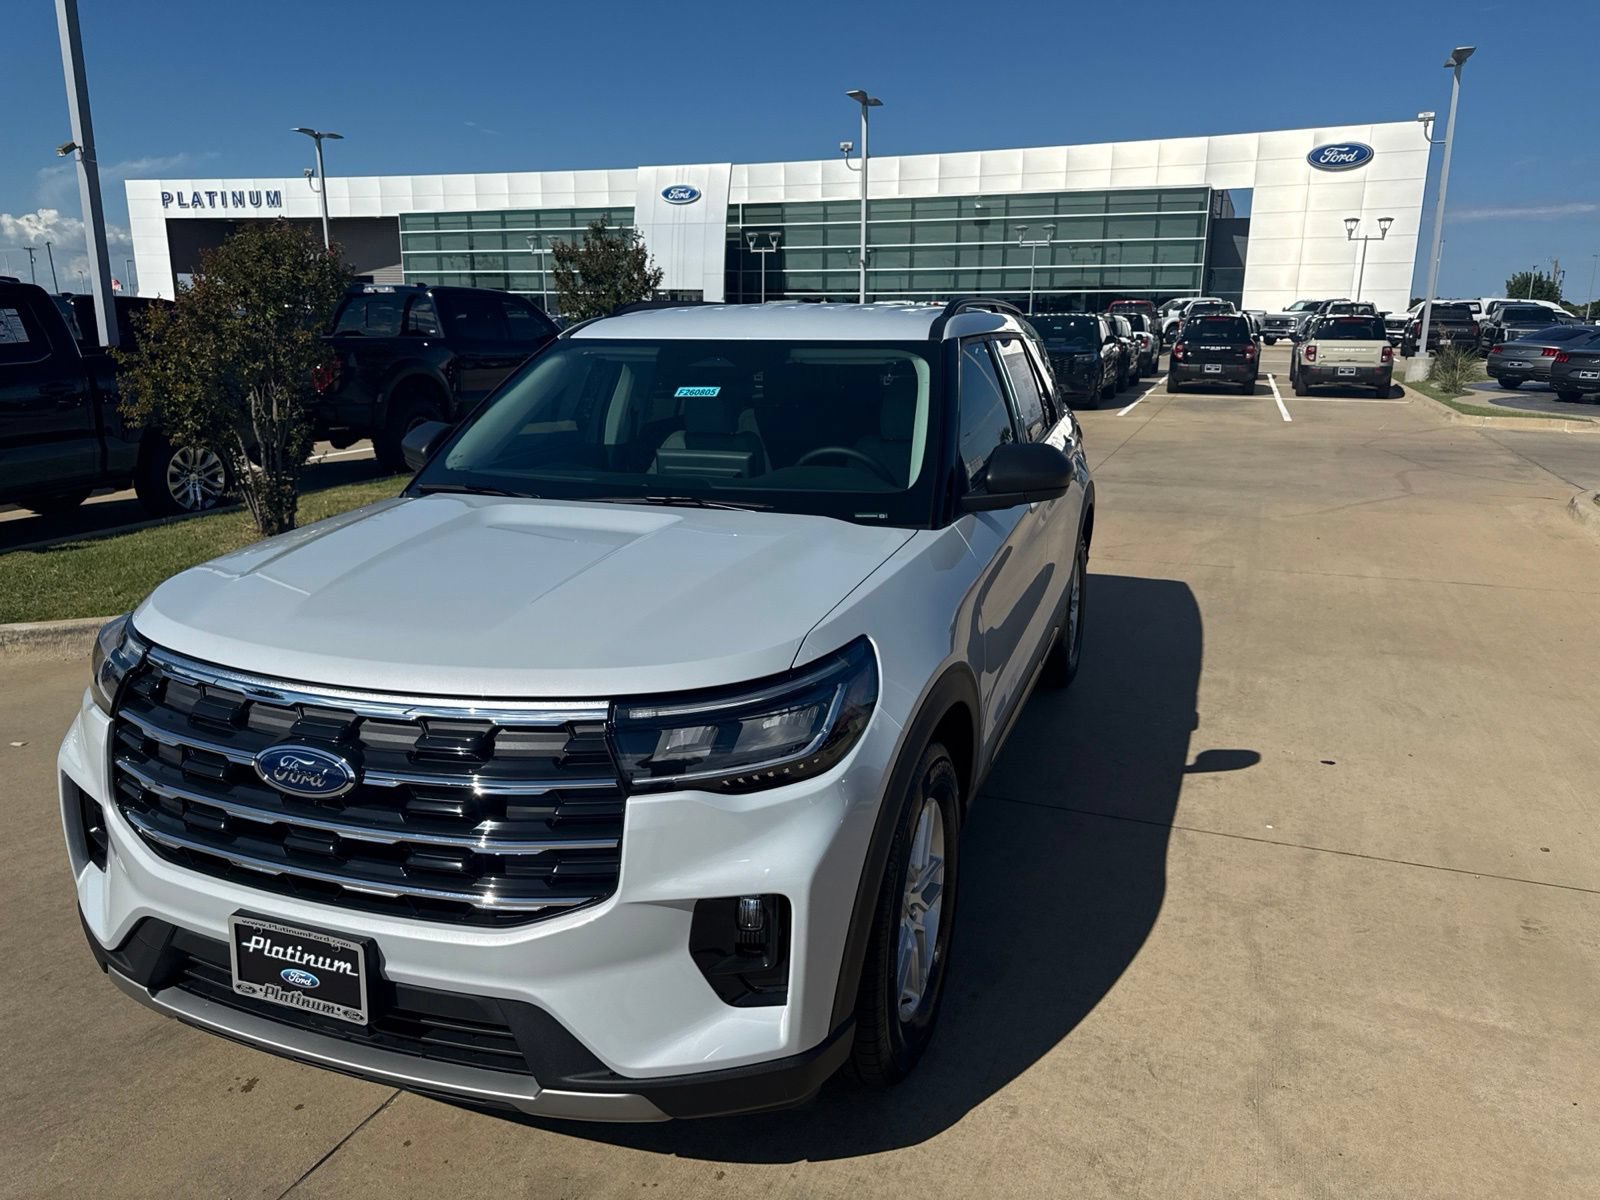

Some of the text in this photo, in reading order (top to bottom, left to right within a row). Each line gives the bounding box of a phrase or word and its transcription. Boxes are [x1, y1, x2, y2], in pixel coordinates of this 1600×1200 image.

[1319, 147, 1359, 163] Ford
[161, 191, 282, 208] PLATINUM
[668, 188, 691, 199] Ford
[678, 388, 717, 396] F260805
[273, 755, 328, 787] Ford
[241, 936, 359, 976] Platinum
[288, 971, 312, 986] Ford
[264, 985, 340, 1016] Platinum
